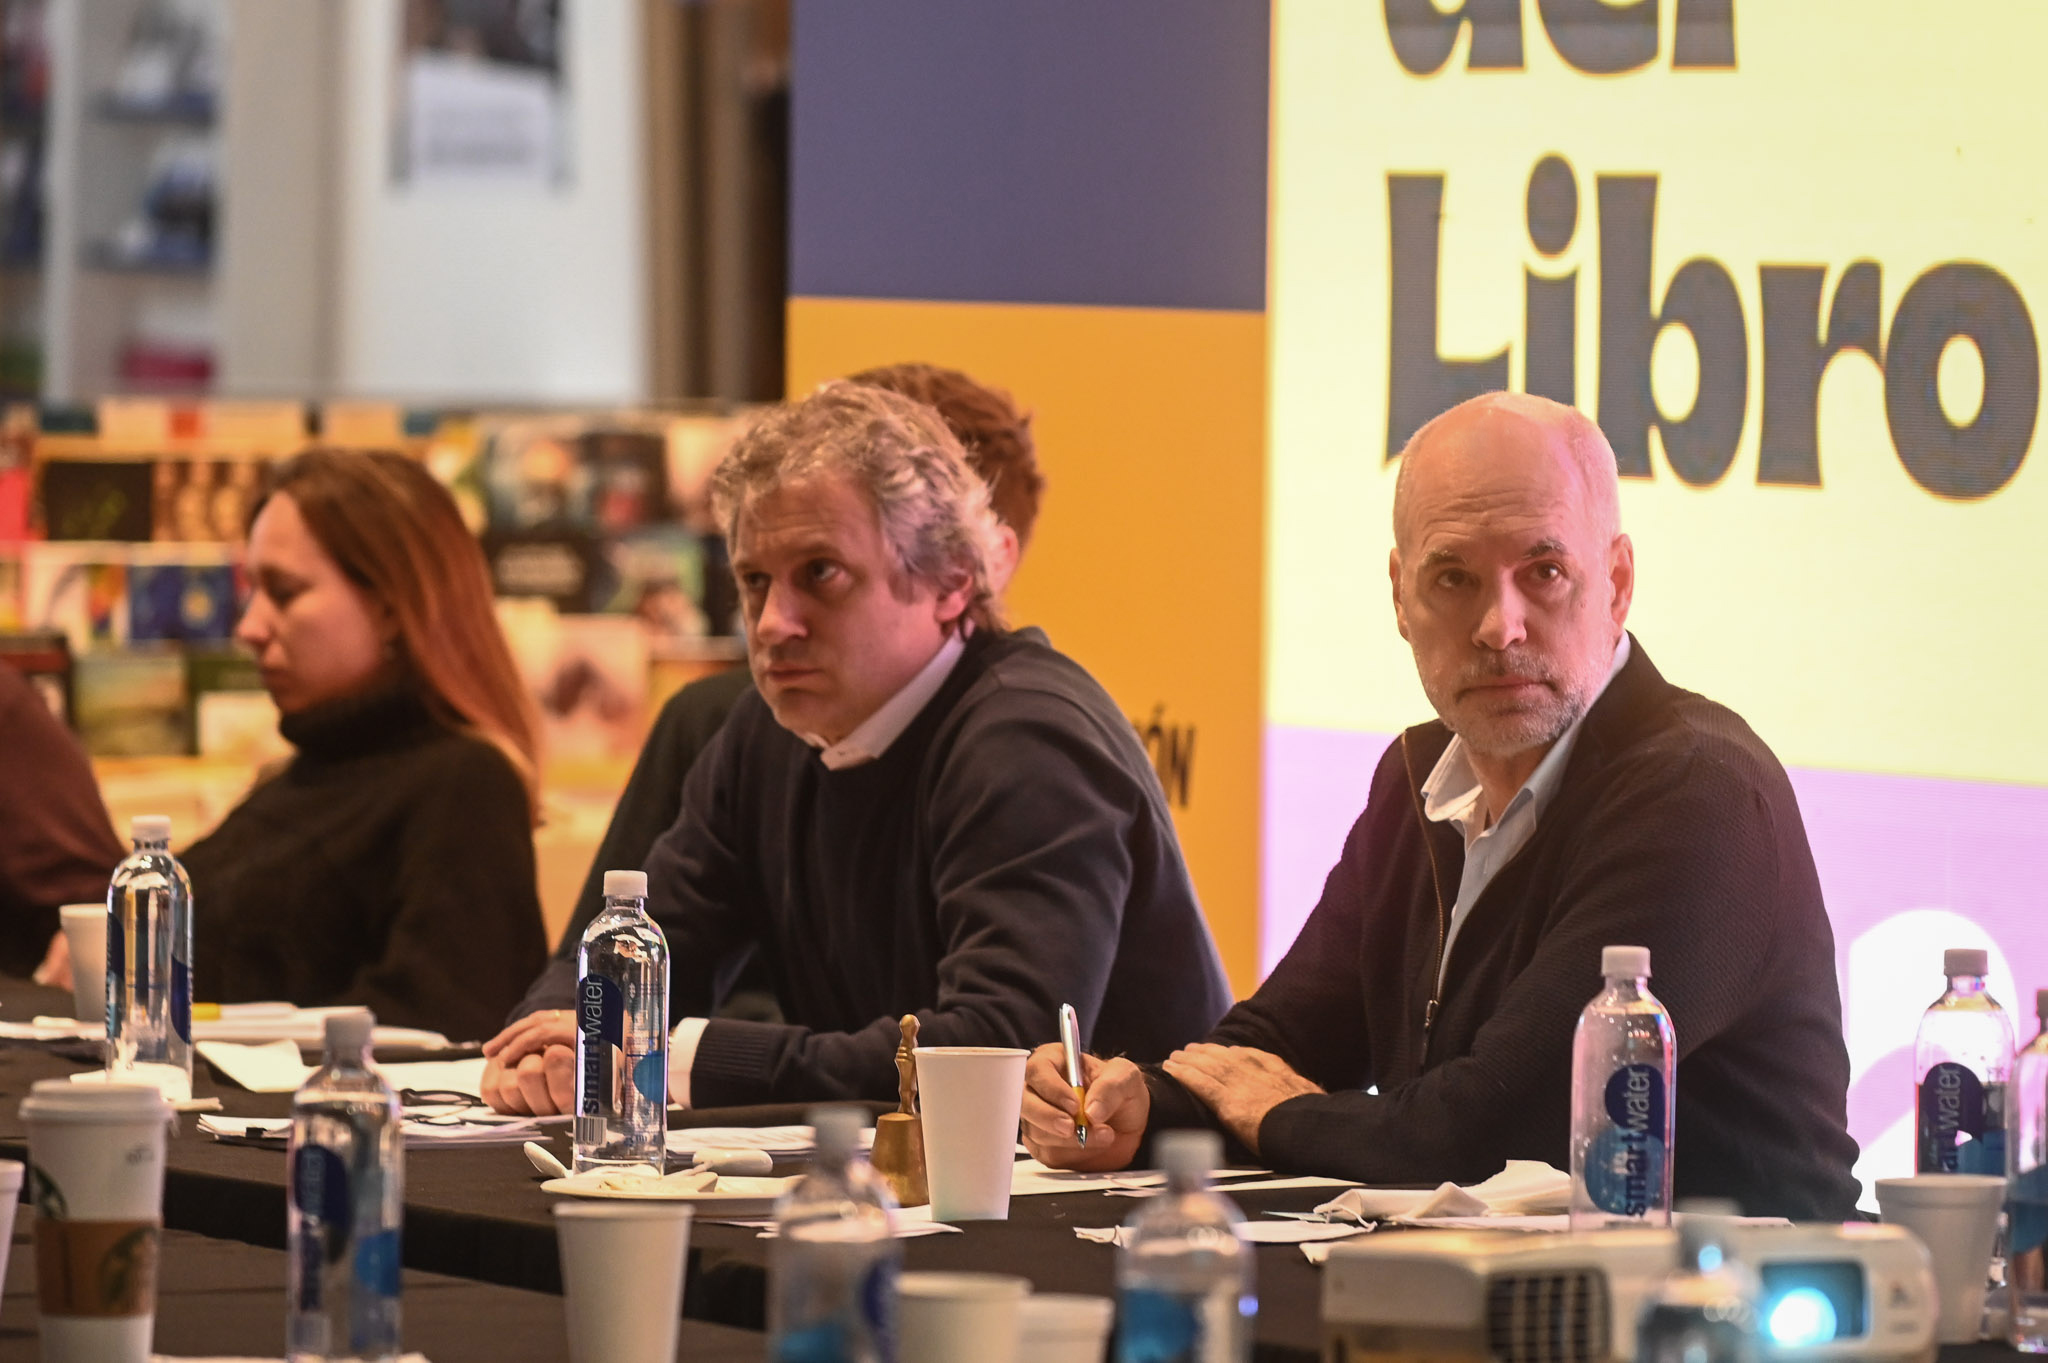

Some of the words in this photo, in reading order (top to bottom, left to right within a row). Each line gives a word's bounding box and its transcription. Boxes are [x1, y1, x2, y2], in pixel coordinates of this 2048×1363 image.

[1384, 152, 2041, 503] Libro
[582, 977, 604, 1114] smartwater
[1620, 1067, 1650, 1217] smartwater
[1934, 1064, 1961, 1172] artwater
